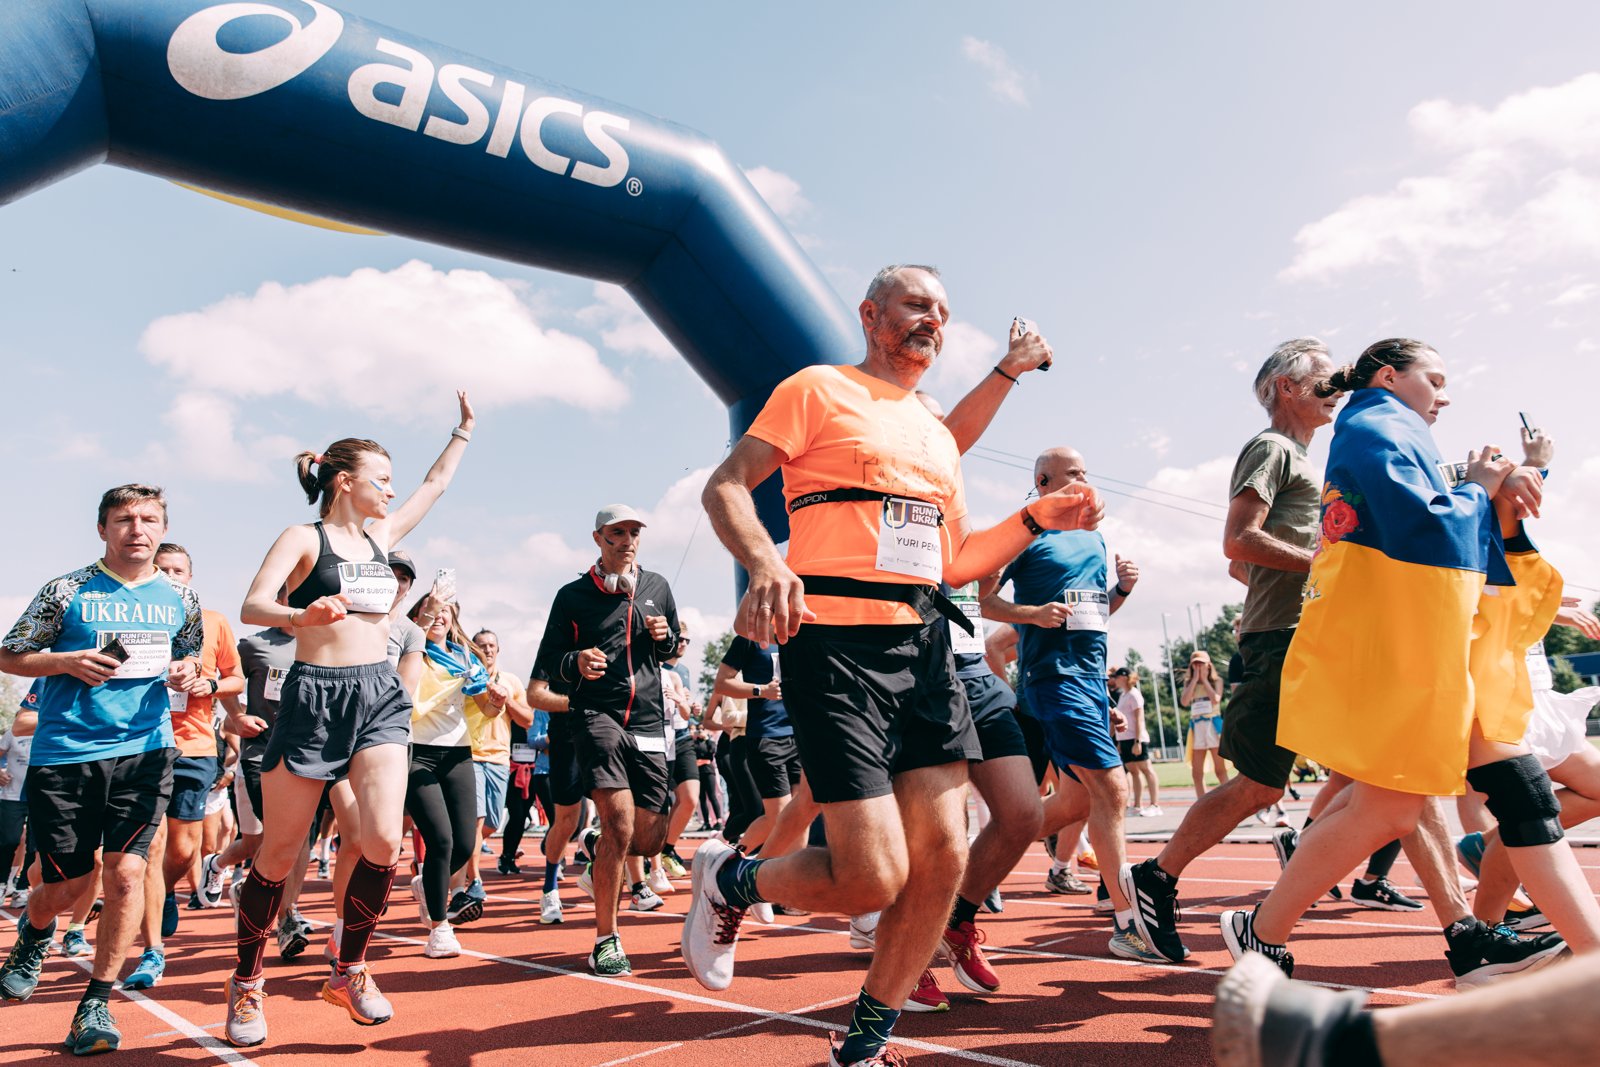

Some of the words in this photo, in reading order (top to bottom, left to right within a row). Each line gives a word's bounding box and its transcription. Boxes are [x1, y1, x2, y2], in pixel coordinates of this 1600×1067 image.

[911, 513, 938, 527] UKRA
[896, 536, 919, 548] YURI
[347, 587, 365, 595] IHOR
[81, 601, 177, 626] UKRAINE
[137, 632, 152, 640] FOR
